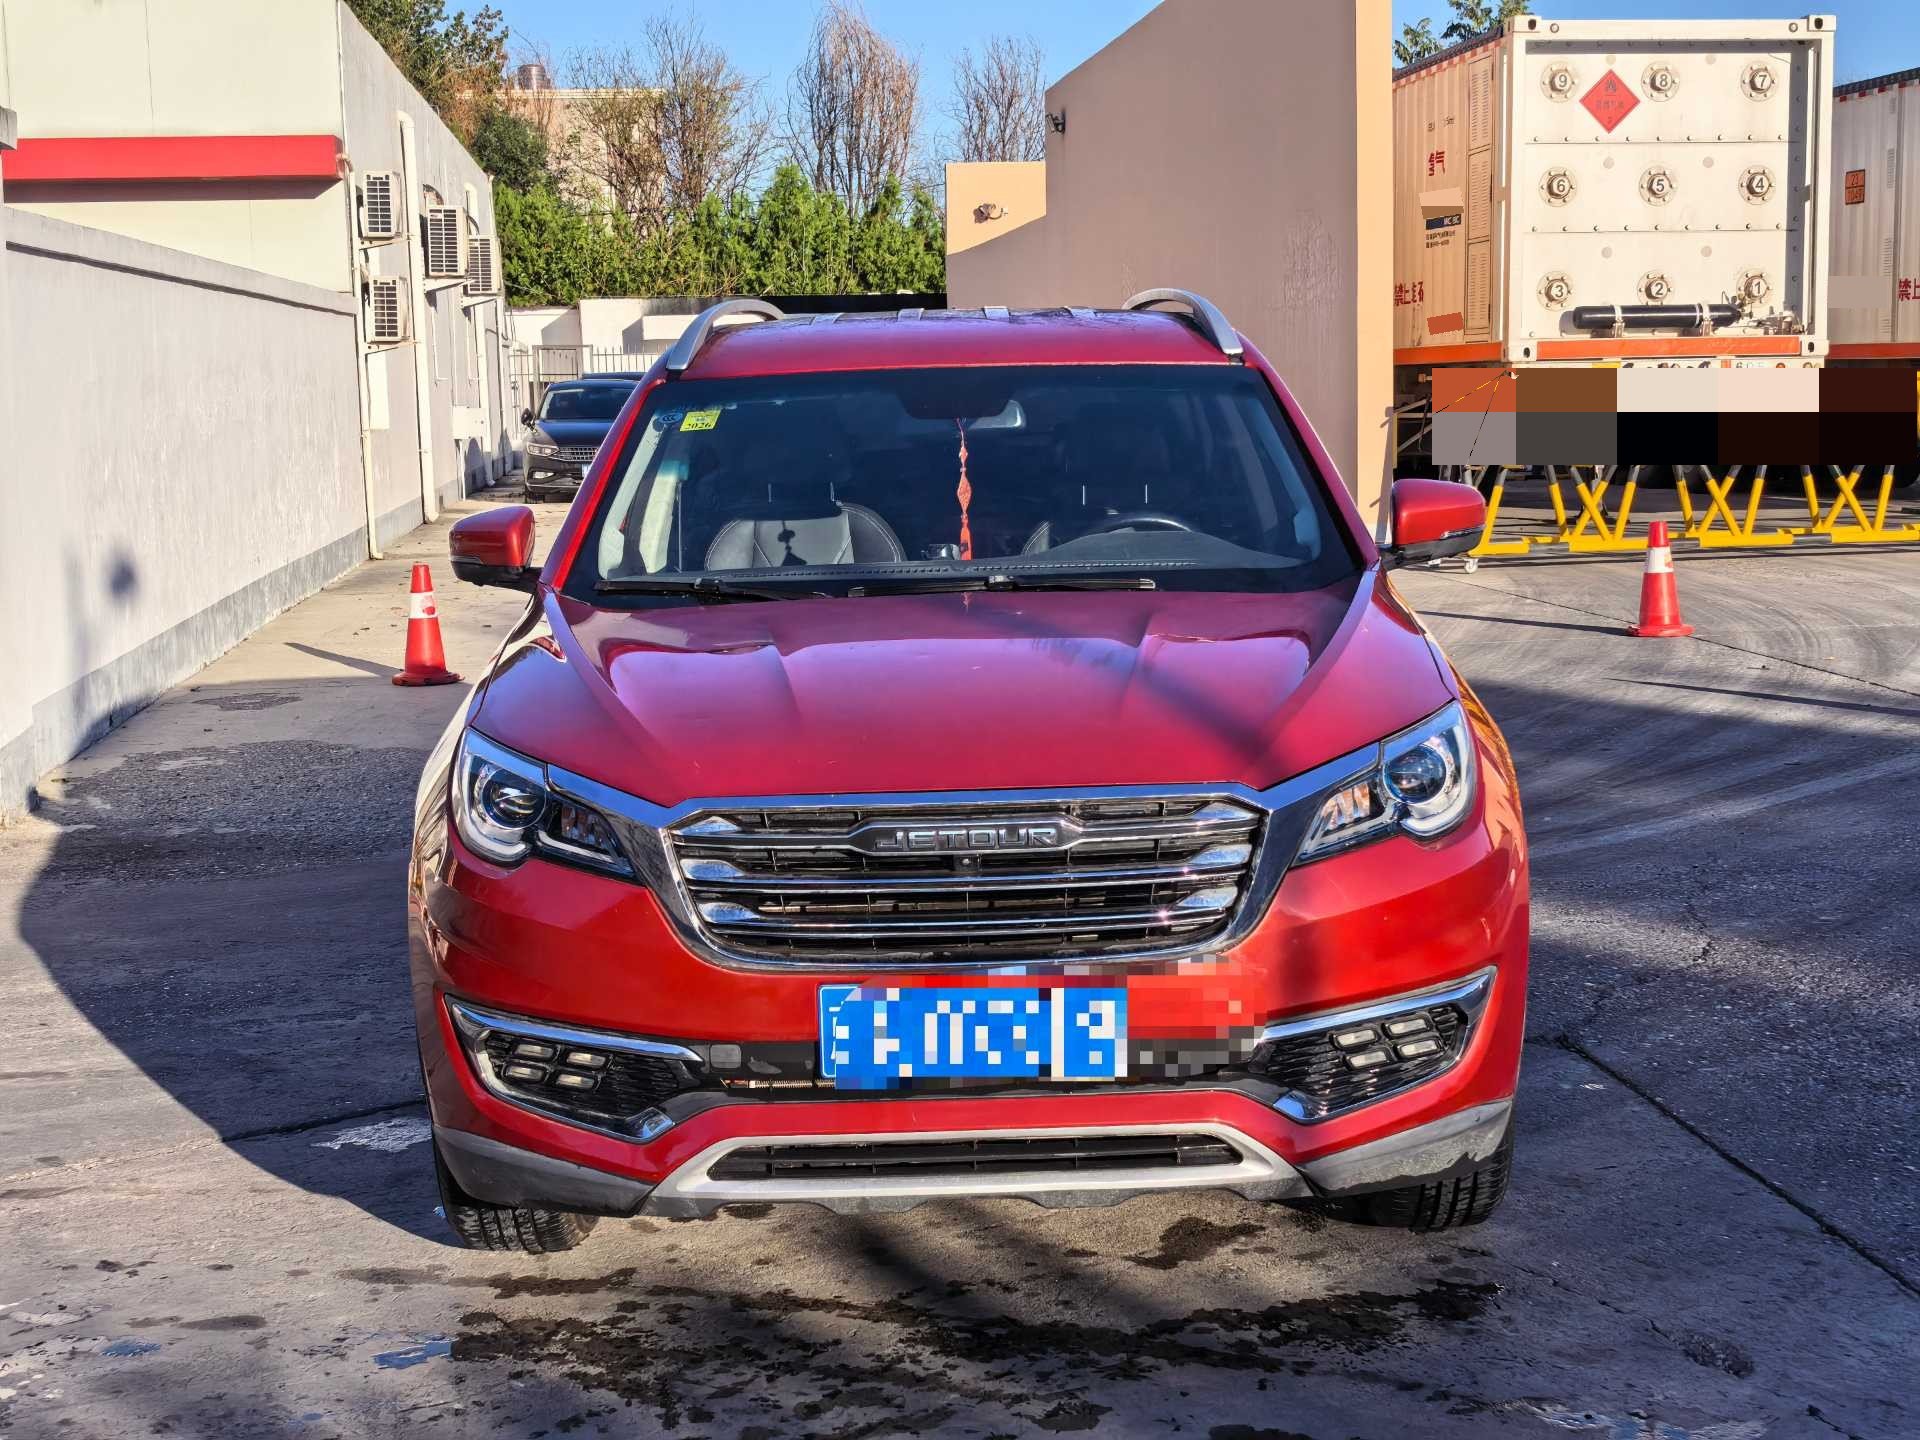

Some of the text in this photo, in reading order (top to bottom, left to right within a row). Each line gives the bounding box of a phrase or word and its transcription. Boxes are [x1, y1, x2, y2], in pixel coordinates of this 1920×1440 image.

[1558, 74, 1568, 88] 9
[1659, 74, 1668, 88] 8
[1758, 74, 1768, 88] 7
[1556, 179, 1566, 193] 6
[1656, 179, 1665, 193] 5
[1755, 177, 1765, 191] 4
[1554, 284, 1564, 298] 3
[1655, 283, 1664, 296] 2
[1754, 282, 1761, 295] 1
[874, 828, 1057, 850] JETOUR
